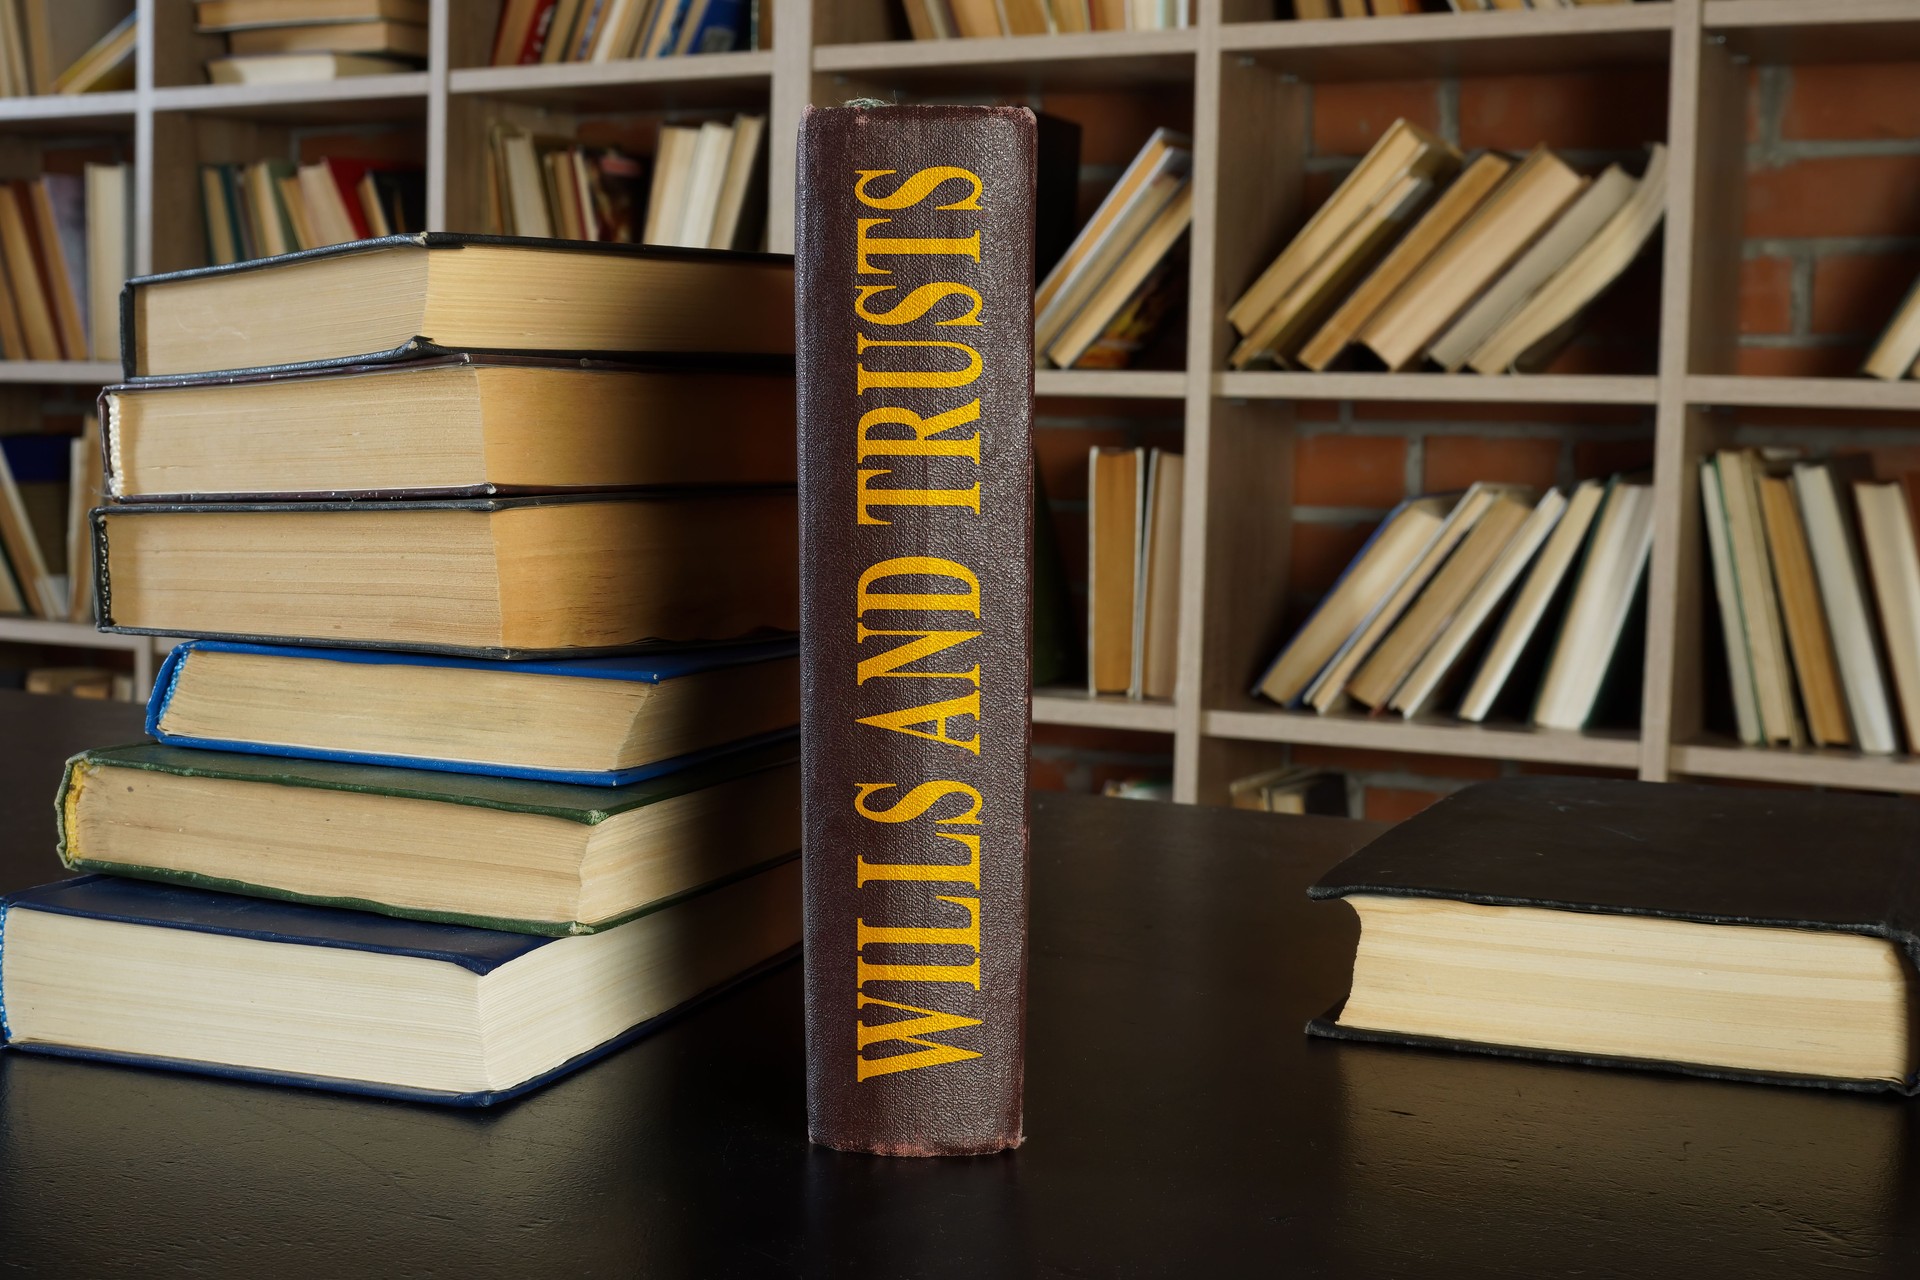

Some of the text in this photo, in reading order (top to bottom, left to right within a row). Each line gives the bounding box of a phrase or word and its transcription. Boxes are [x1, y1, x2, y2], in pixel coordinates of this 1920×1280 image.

[854, 165, 984, 1083] WILLS AND TRUSTS
